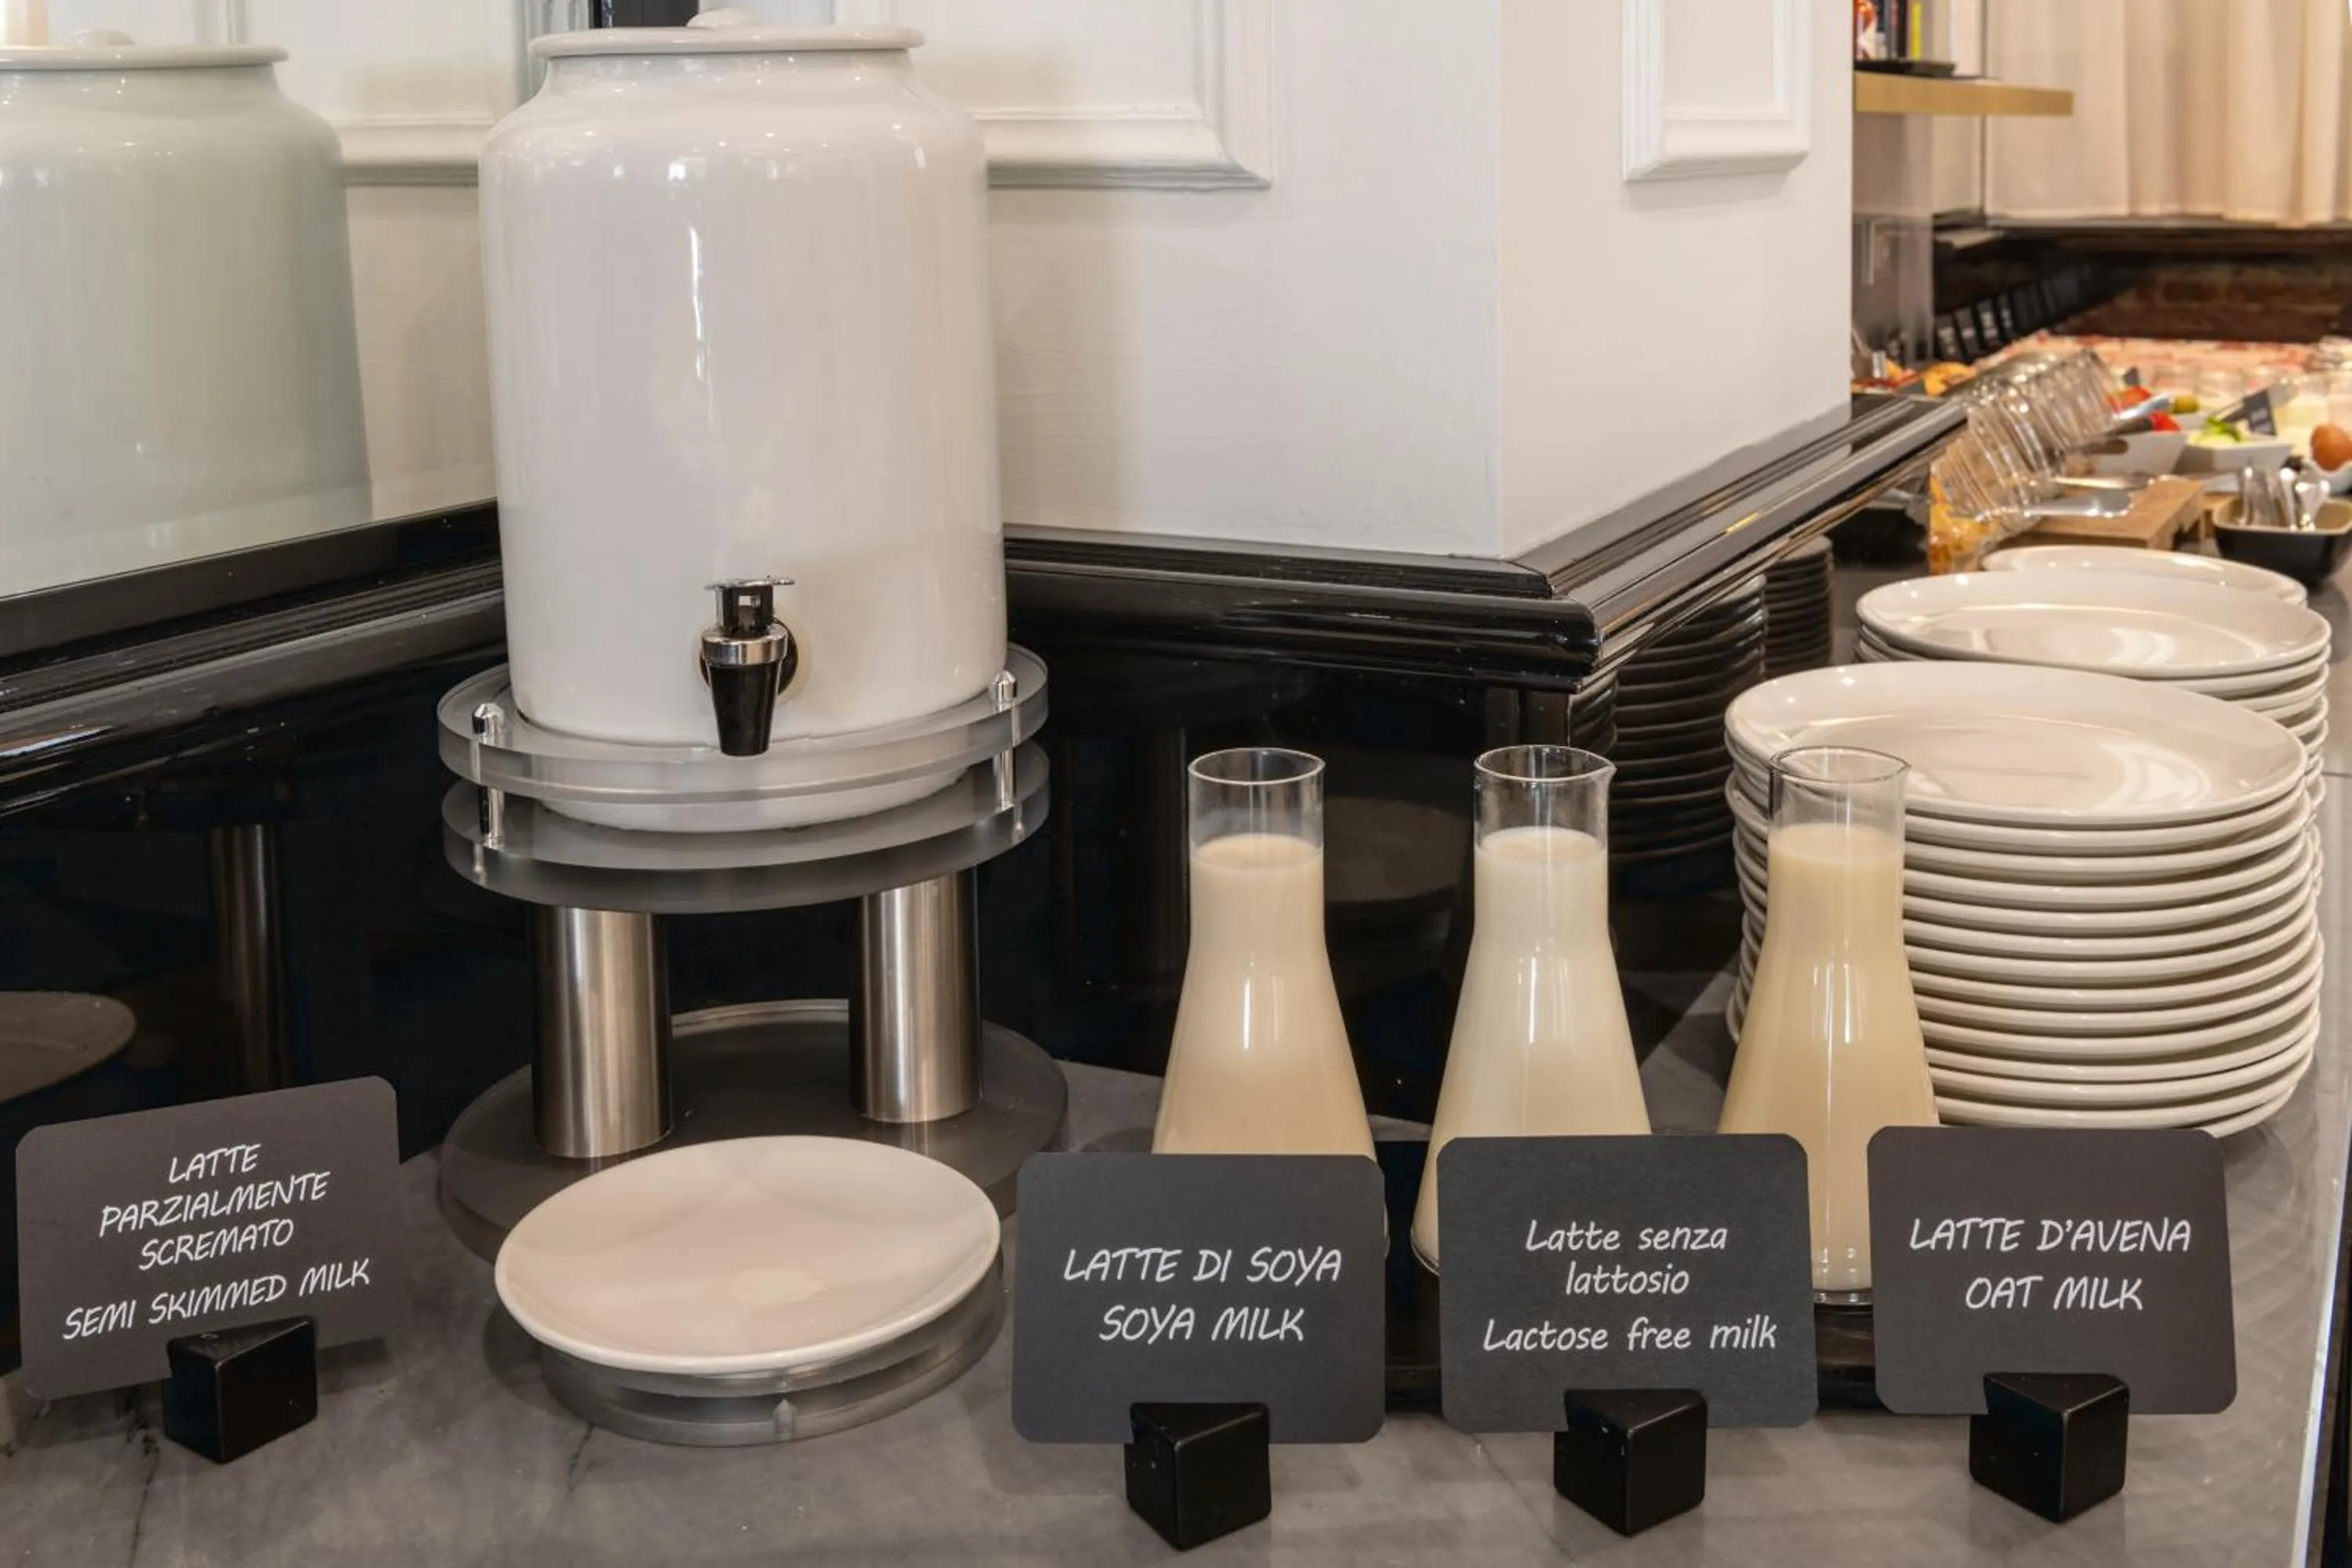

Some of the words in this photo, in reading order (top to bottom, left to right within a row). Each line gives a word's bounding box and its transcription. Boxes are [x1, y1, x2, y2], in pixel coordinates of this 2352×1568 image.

[169, 1143, 261, 1184] LATTE
[99, 1171, 330, 1237] PARZIALMENTE
[139, 1219, 294, 1271] SCREMATO
[1526, 1219, 1621, 1252] Latte
[1638, 1226, 1728, 1250] senza
[1909, 1217, 2025, 1252] LATTE
[2036, 1217, 2191, 1253] D'AVENA
[1063, 1247, 1183, 1283] LATTE
[1192, 1249, 1232, 1283] DI
[1246, 1246, 1341, 1287] SOYA
[1566, 1260, 1690, 1295] lattosio
[62, 1299, 136, 1340] SEMI
[148, 1274, 287, 1324] SKIMMED
[299, 1258, 370, 1297] MILK
[1965, 1275, 2044, 1309] OAT
[2053, 1276, 2143, 1310] MILK
[1098, 1304, 1196, 1345] SOYA
[1211, 1306, 1305, 1341] MILK
[1483, 1319, 1609, 1352] Lactose
[1627, 1316, 1691, 1352] free
[1709, 1314, 1777, 1349] milk
